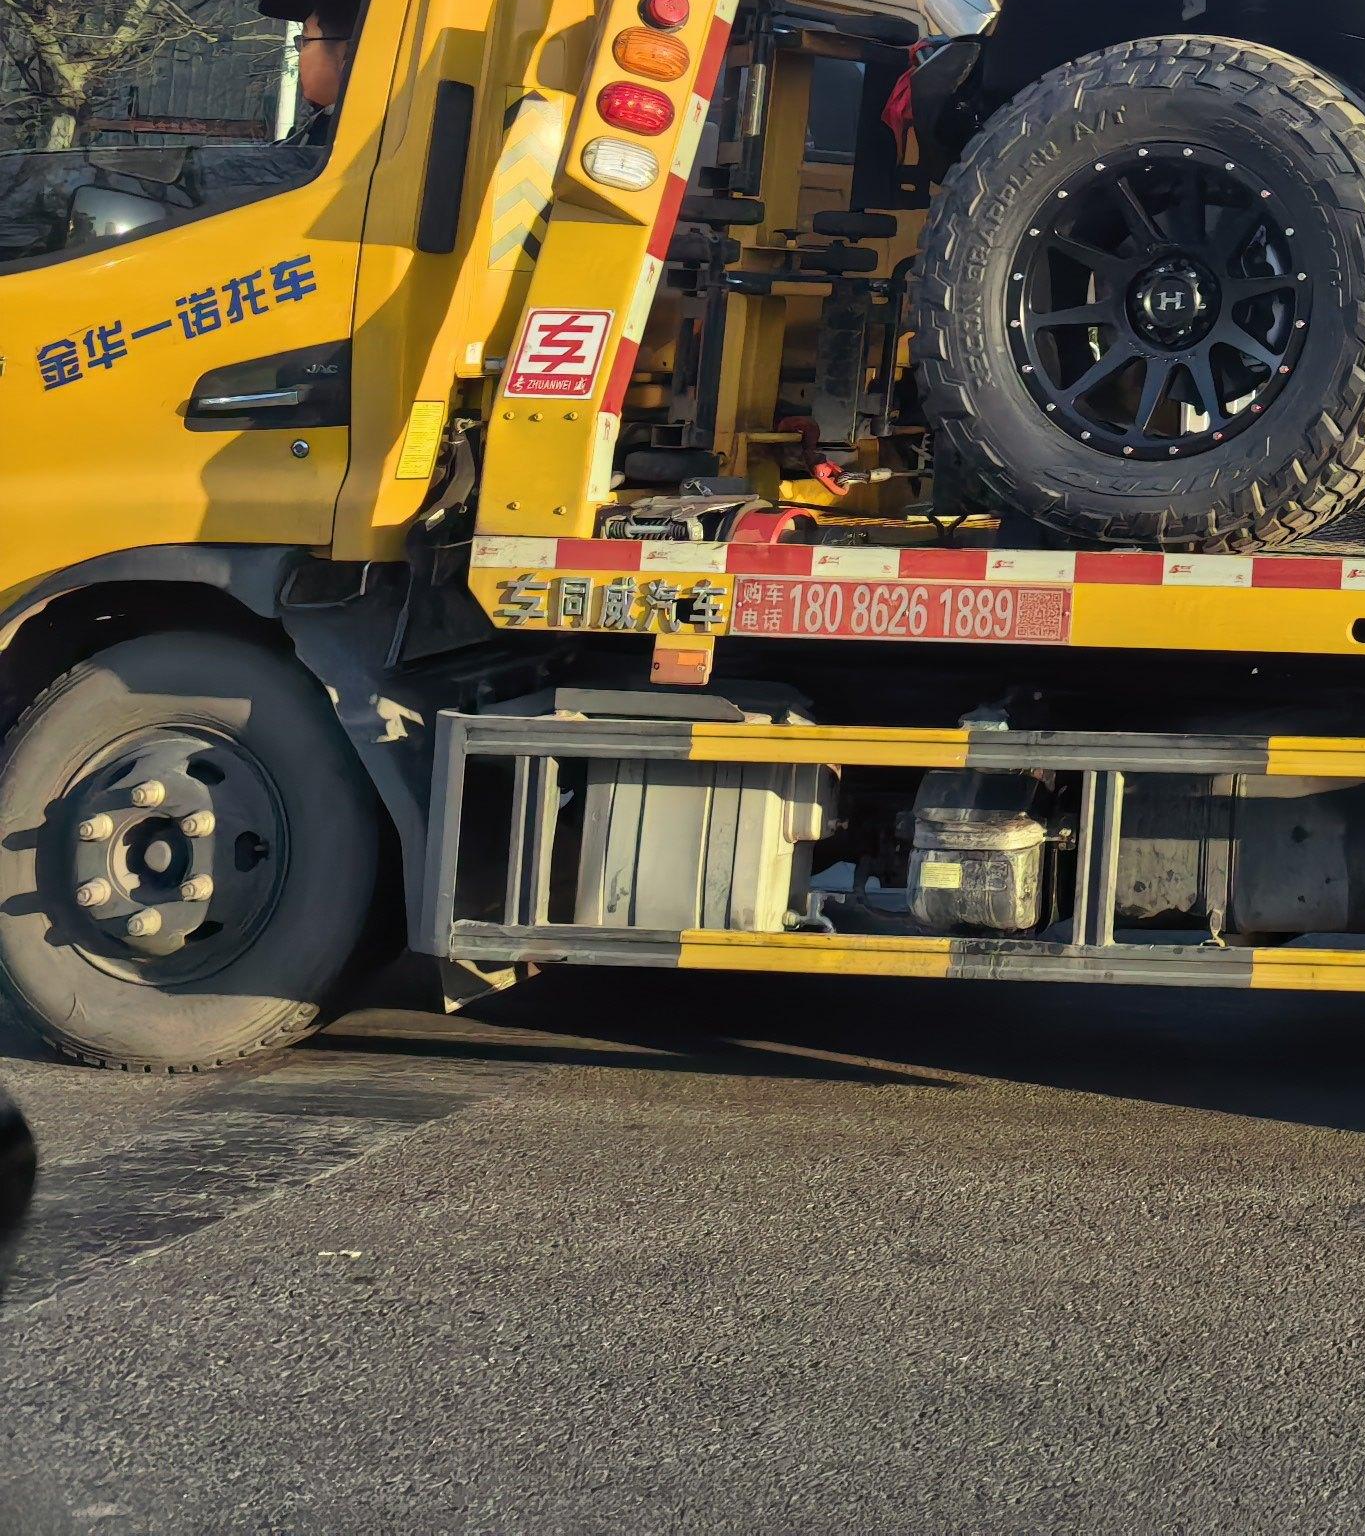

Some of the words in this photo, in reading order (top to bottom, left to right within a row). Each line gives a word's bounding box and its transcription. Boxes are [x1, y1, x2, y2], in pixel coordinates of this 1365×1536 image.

[36, 254, 317, 392] 金华一诺托车
[526, 379, 572, 391] ZHUANWEI
[742, 582, 784, 606] 购车
[741, 607, 783, 632] 电话
[789, 582, 843, 634] 180
[850, 583, 929, 637] 8626
[938, 586, 1015, 639] 1889
